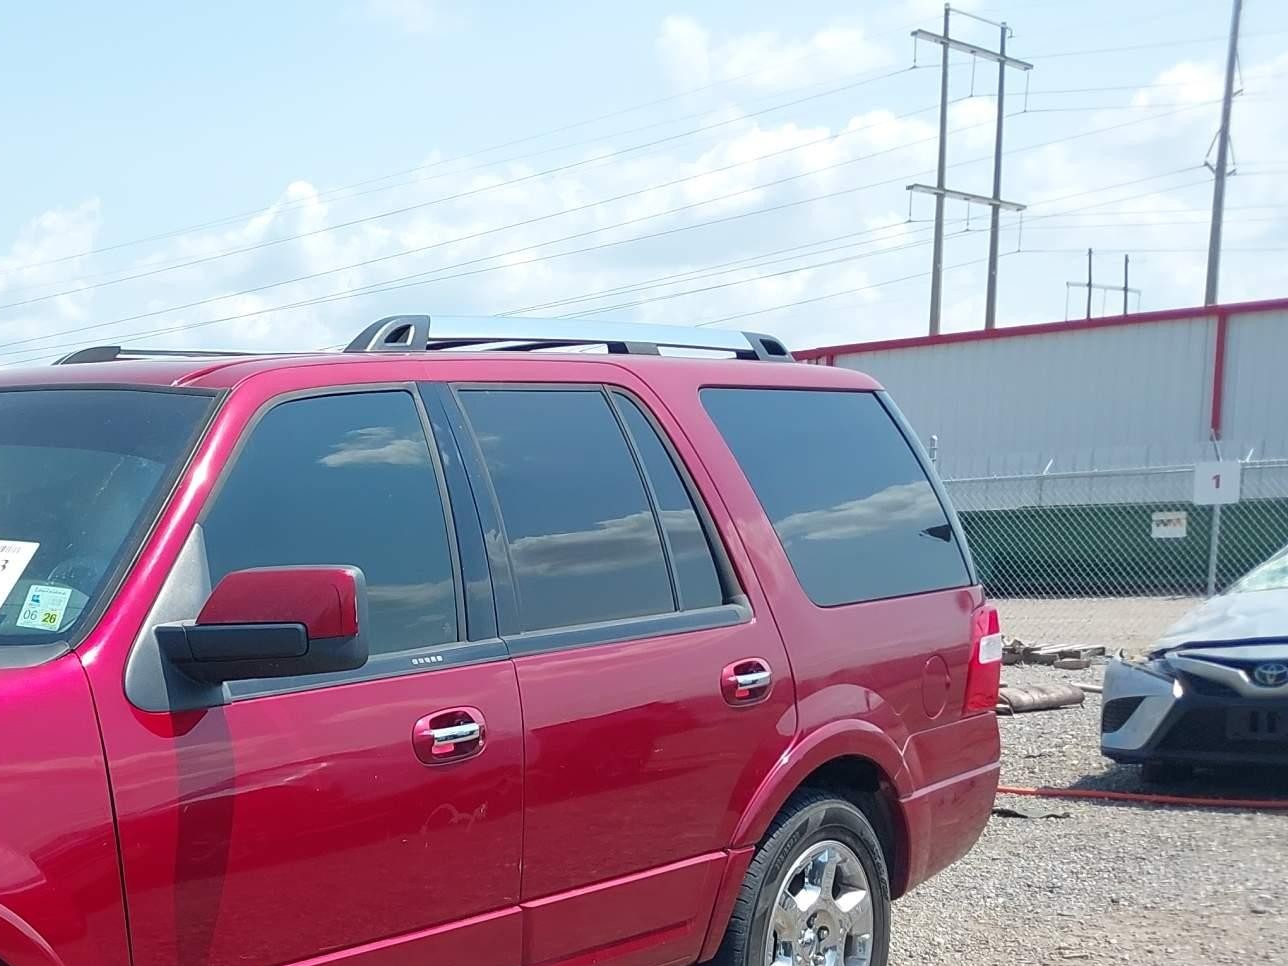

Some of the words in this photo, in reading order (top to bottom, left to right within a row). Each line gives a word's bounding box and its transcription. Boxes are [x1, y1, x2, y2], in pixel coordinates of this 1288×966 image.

[1212, 474, 1221, 489] 1
[23, 609, 38, 621] 06
[41, 612, 57, 624] 26
